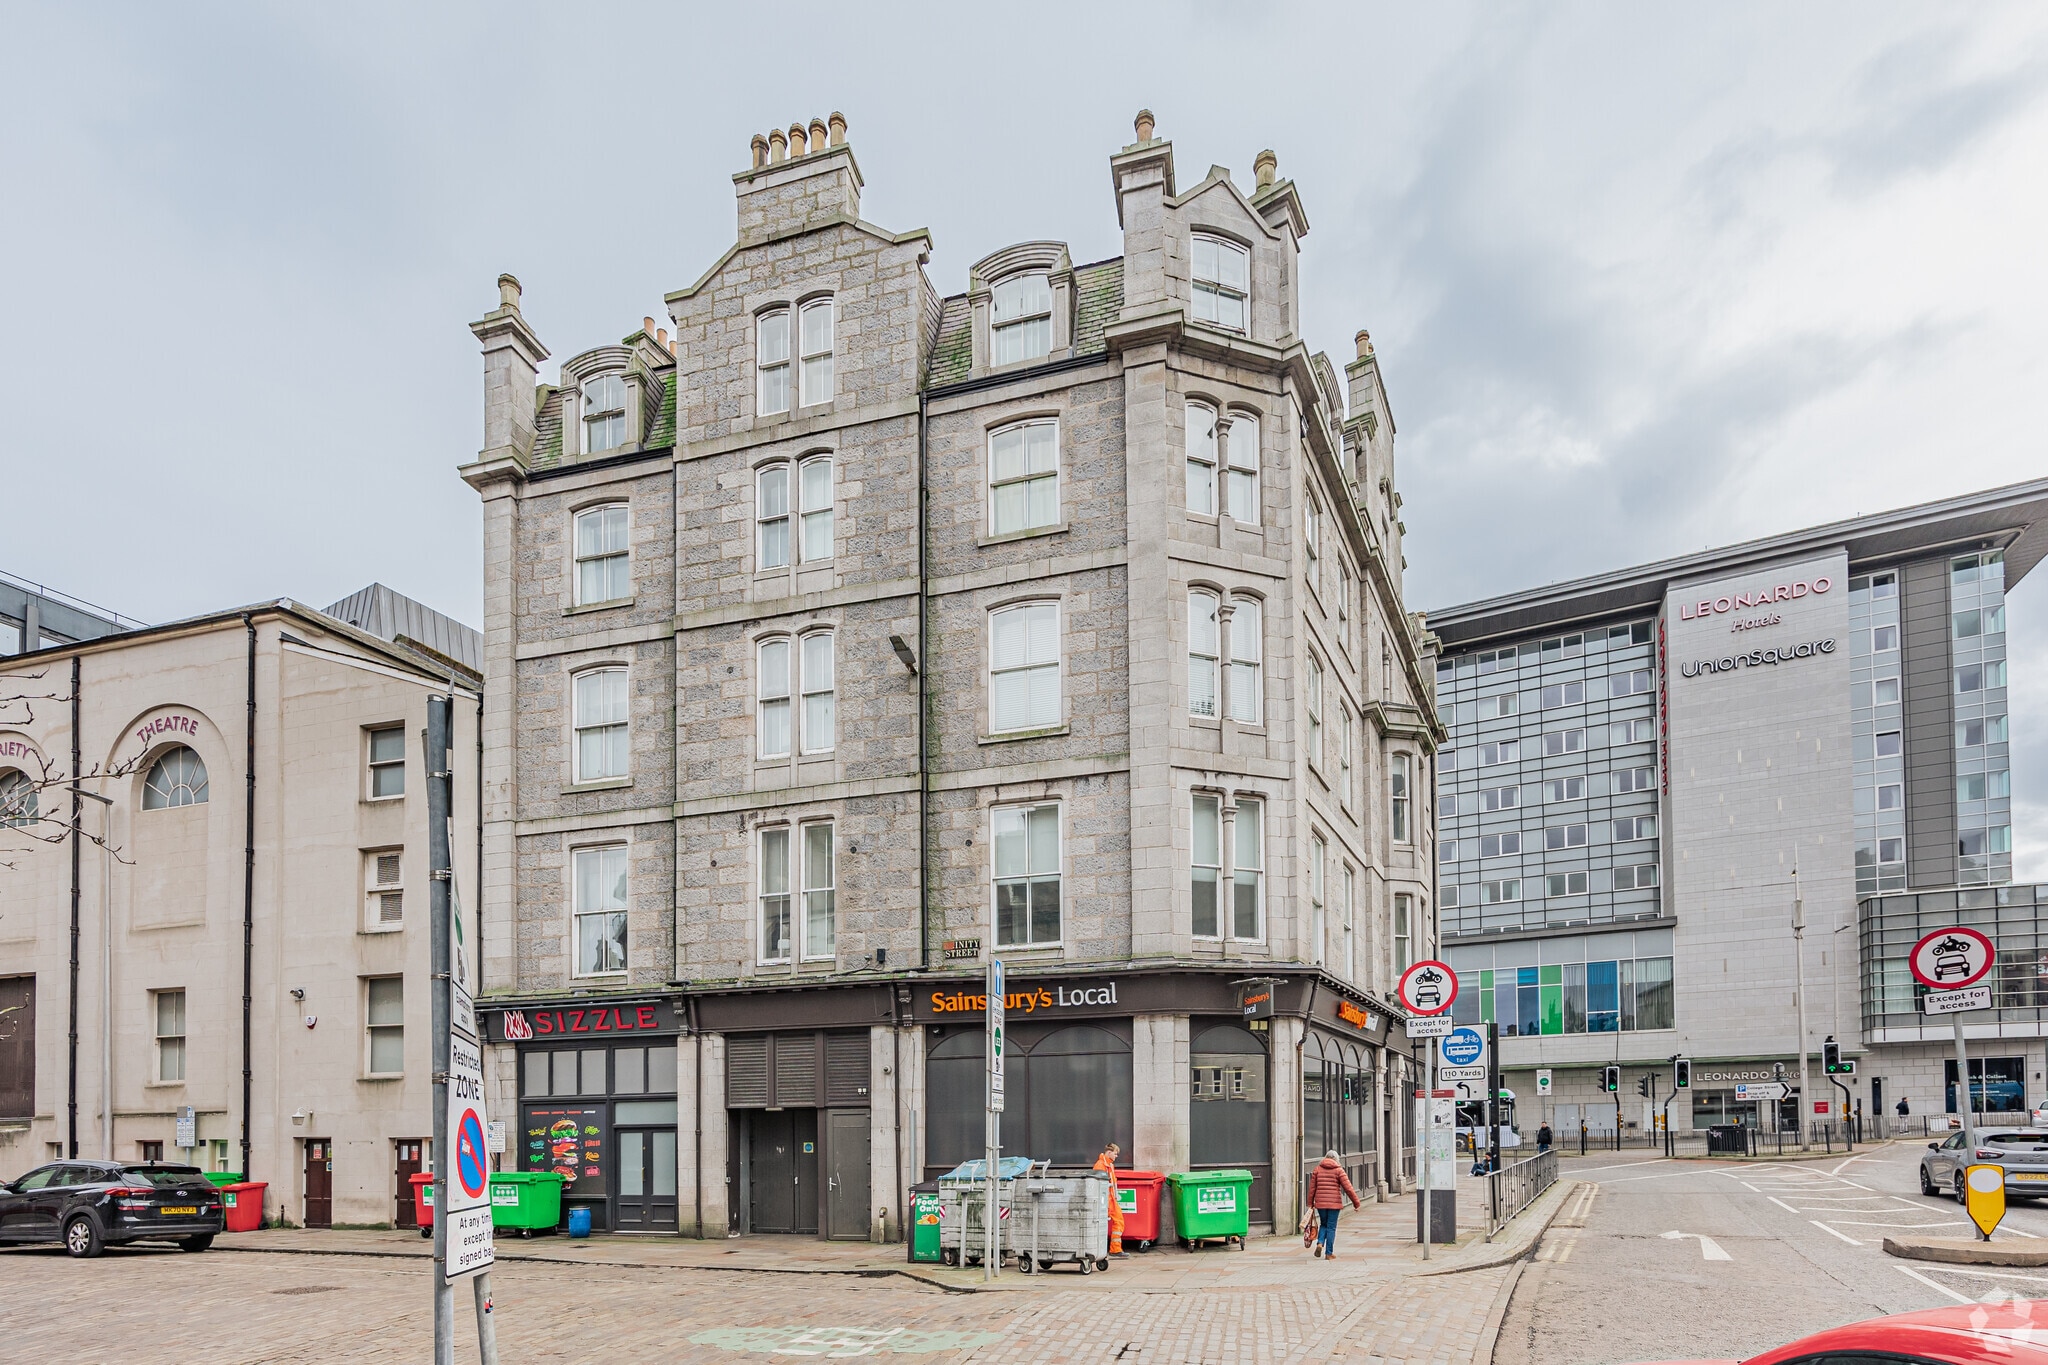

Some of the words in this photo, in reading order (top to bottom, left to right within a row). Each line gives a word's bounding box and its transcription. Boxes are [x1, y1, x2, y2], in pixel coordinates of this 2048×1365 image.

[1681, 576, 1832, 620] LEONARDO
[1731, 611, 1782, 633] Hotels
[136, 715, 199, 743] THEATRE
[951, 940, 980, 949] INITY
[945, 948, 979, 958] STREET
[931, 987, 1053, 1013] Sainsury's
[1058, 982, 1118, 1007] Local
[1244, 991, 1270, 1005] Sainsbury's
[1928, 992, 1966, 1003] Except
[1244, 1003, 1257, 1015] Local
[1939, 1000, 1976, 1010] access
[535, 1006, 658, 1034] SIZZLE
[453, 1044, 480, 1072] Restricted
[1696, 1071, 1769, 1081] LEONARDO
[456, 1074, 480, 1100] ZONE
[916, 1197, 939, 1206] Food
[919, 1204, 940, 1213] Only
[460, 1217, 467, 1229] At
[469, 1216, 480, 1228] any
[463, 1230, 486, 1246] except
[460, 1248, 482, 1265] signed
